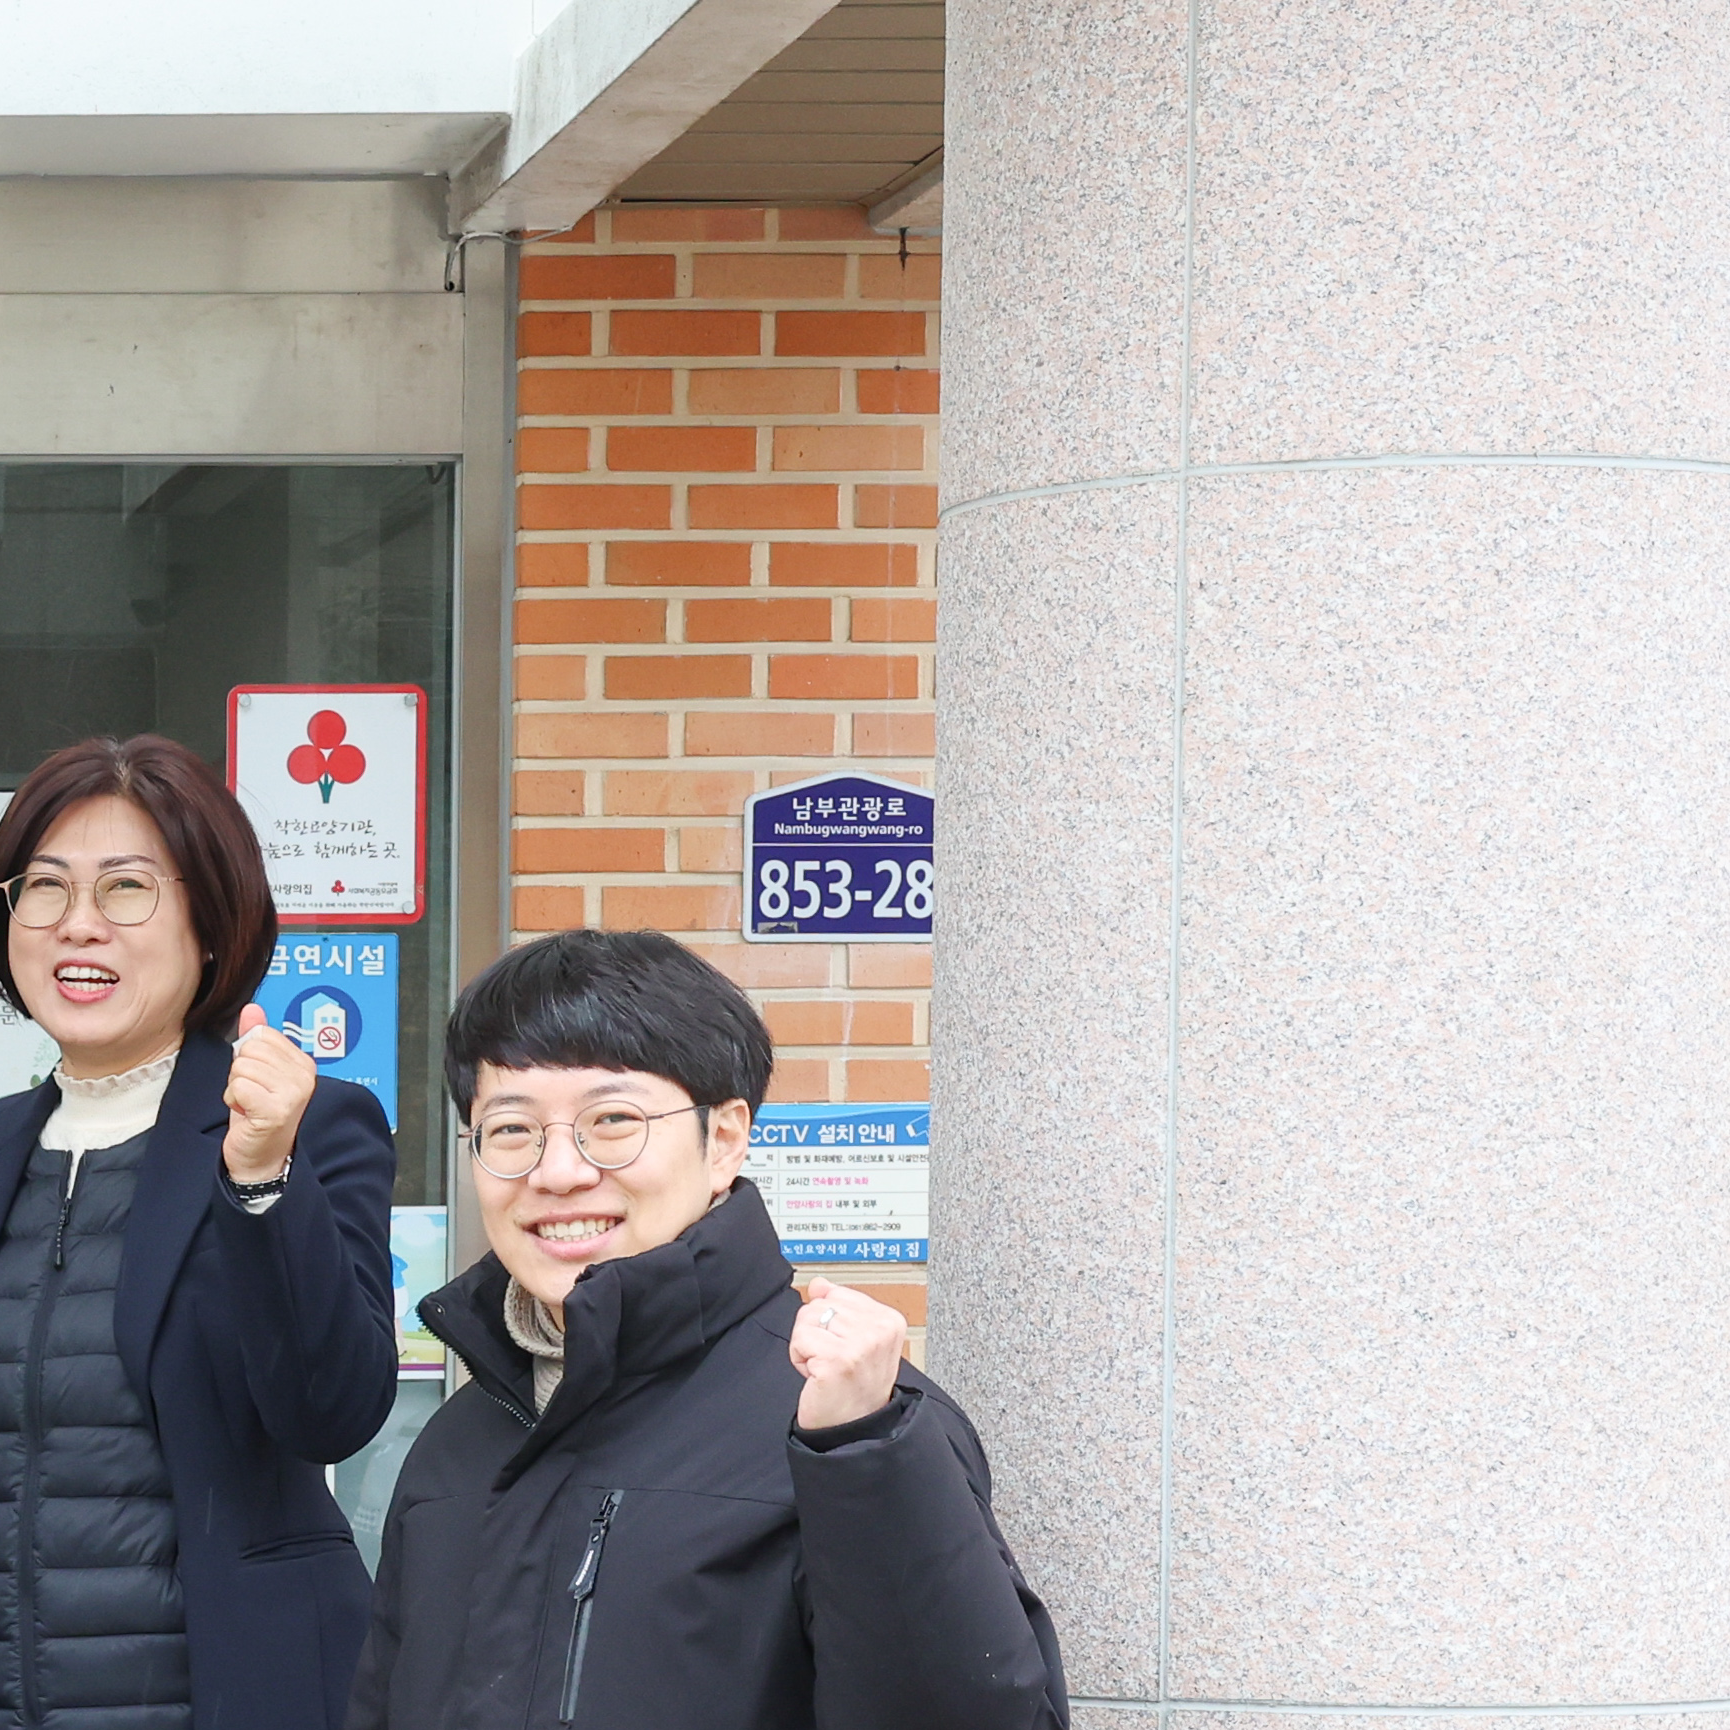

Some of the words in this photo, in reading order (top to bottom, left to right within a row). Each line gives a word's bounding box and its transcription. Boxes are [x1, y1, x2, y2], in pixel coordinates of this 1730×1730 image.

[792, 796, 907, 822] 남부관광로
[773, 822, 924, 838] Nambugwangwang-ro
[262, 842, 305, 859] 눔으로
[313, 841, 379, 859] 함께하는
[270, 884, 313, 895] 사랑의집
[758, 859, 934, 919] 853-28
[266, 944, 385, 976] 금연시설
[748, 1124, 809, 1144] CCTV
[817, 1124, 854, 1144] 설치
[858, 1123, 896, 1144] 안내
[786, 1176, 810, 1186] 24시간
[835, 1199, 850, 1209] 내부
[853, 1241, 901, 1259] 사랑의
[905, 1241, 920, 1259] 집
